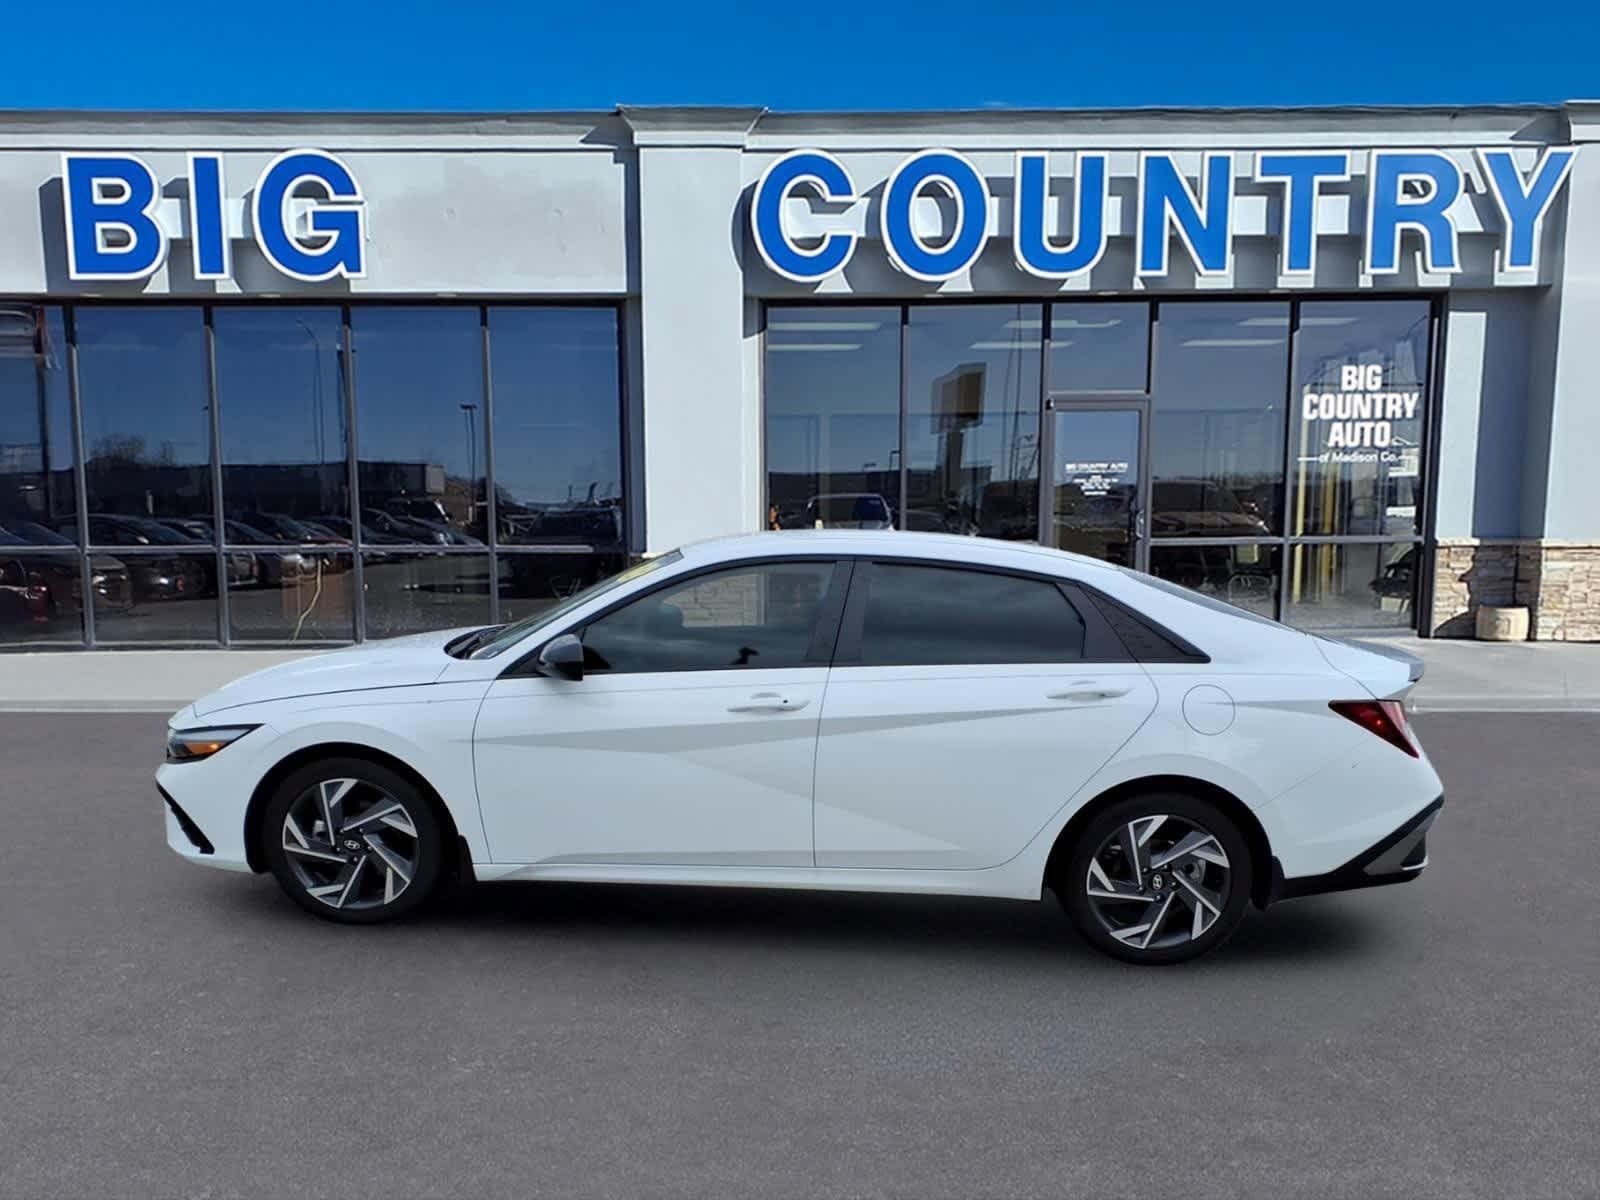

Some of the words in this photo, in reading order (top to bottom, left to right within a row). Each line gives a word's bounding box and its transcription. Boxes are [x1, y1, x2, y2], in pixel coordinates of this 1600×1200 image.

[61, 149, 367, 281] BIG
[750, 147, 1579, 284] COUNTRY
[1341, 364, 1382, 391] BIG
[1303, 392, 1419, 420] COUNTRY
[1327, 421, 1391, 448] AUTO
[1331, 451, 1378, 462] Madison
